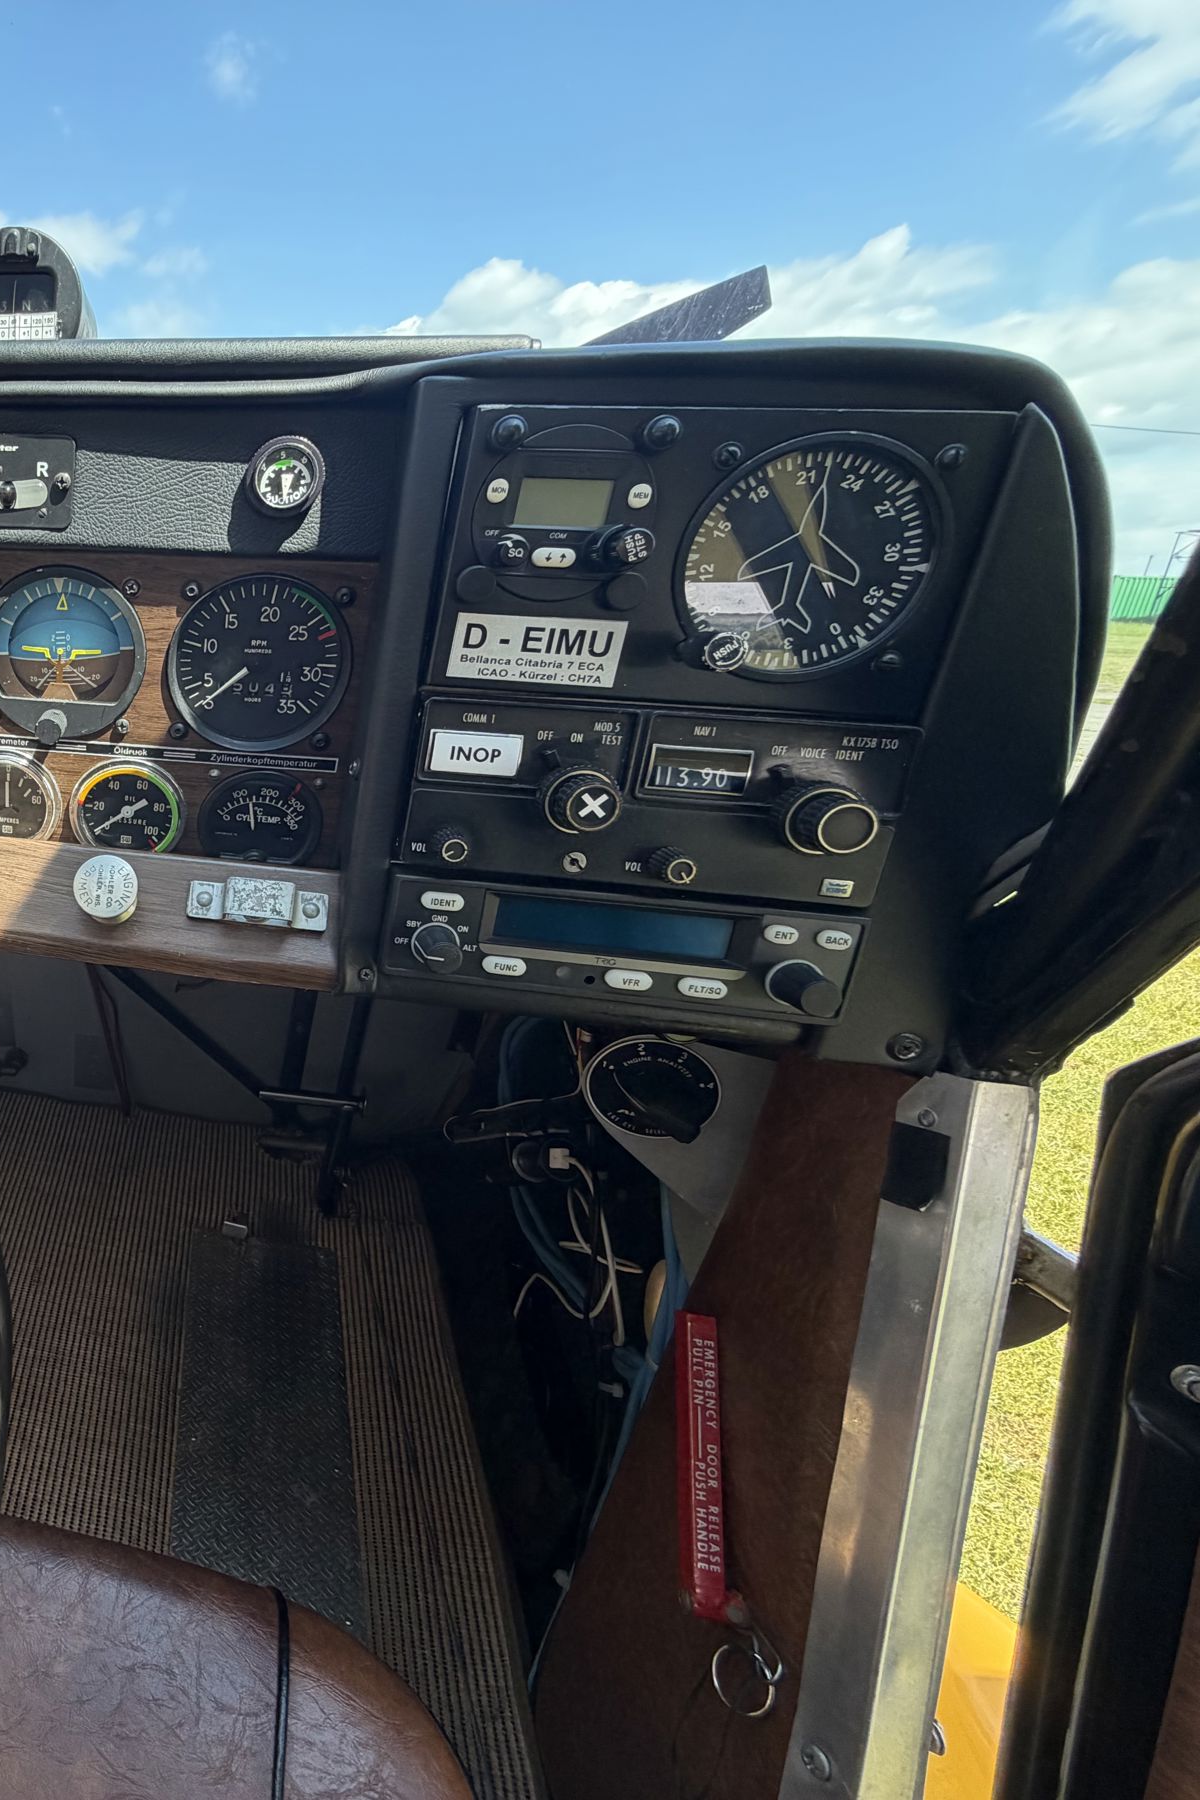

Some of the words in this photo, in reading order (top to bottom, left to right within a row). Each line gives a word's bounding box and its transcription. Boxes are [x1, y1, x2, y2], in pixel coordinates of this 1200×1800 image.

[37, 462, 48, 477] R
[796, 470, 816, 485] 21
[840, 475, 864, 492] 24
[633, 492, 649, 500] MEM
[485, 529, 500, 537] OFF
[550, 532, 567, 540] COM
[628, 535, 636, 562] PUSH
[638, 533, 647, 558] STEP
[508, 549, 523, 557] SQ
[260, 607, 280, 622] 20
[289, 626, 308, 641] 25
[462, 623, 488, 649] D
[521, 626, 614, 657] EIMU
[713, 642, 738, 659] PUSH
[460, 654, 511, 667] Bellanca
[515, 657, 563, 670] Citabria
[567, 661, 575, 669] 7
[578, 662, 605, 672] ECA
[301, 667, 321, 681] 30
[477, 668, 508, 678] ICAO
[519, 670, 557, 682] Kürzel
[568, 674, 601, 684] CH7A
[463, 713, 487, 723] COMM
[594, 722, 613, 732] MOD
[694, 726, 712, 737] NAV
[537, 731, 554, 741] OFF
[570, 733, 584, 743] ON
[602, 735, 623, 746] TEST
[842, 736, 857, 748] KX
[881, 739, 899, 749] TSO
[114, 747, 148, 757] Öldruck
[450, 746, 501, 763] INOP
[771, 745, 788, 756] OFF
[799, 747, 826, 759] VOICE
[835, 750, 864, 761] IDENT
[210, 754, 318, 768] Zylinderkopftemperatur
[411, 843, 426, 852] VOL
[625, 862, 641, 872] VOL
[78, 866, 96, 907] PRIMER
[118, 866, 134, 909] ENGINE
[431, 898, 457, 908] IDENT
[406, 920, 422, 928] SBY
[457, 925, 469, 933] ON
[774, 931, 795, 940] ENT
[825, 936, 849, 946] BACK
[463, 944, 477, 952] ALT
[494, 963, 517, 972] FUNC
[622, 978, 640, 987] VFR
[688, 984, 722, 995] FLT/SQ
[692, 1338, 703, 1370] PULL
[704, 1339, 718, 1429] EMERGENCY
[694, 1380, 704, 1405] PIN
[706, 1444, 718, 1489] DOOR
[695, 1461, 706, 1501] PUSH
[695, 1507, 709, 1571] HANDLE
[708, 1504, 721, 1573] RELEASE
